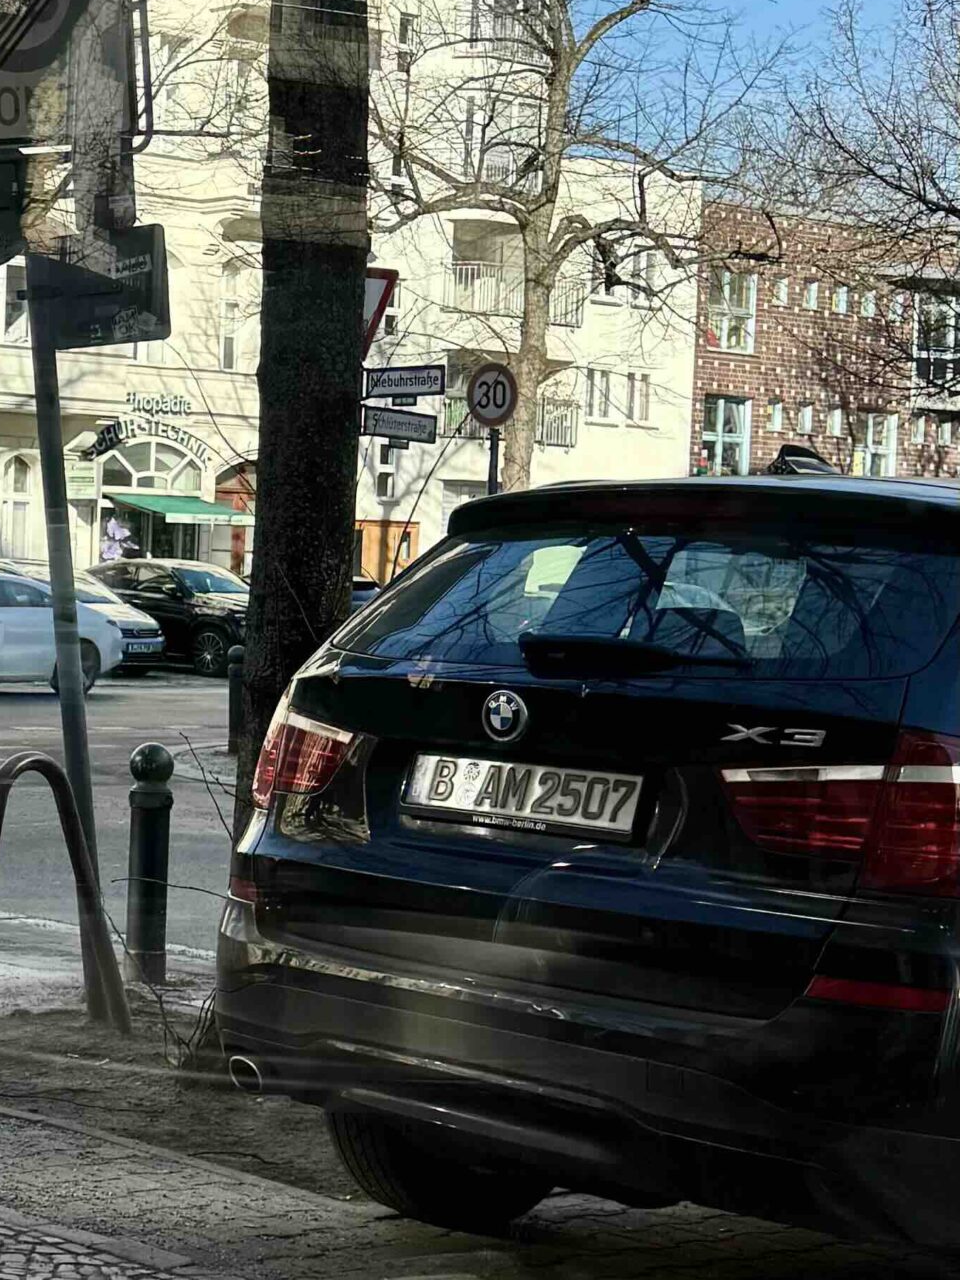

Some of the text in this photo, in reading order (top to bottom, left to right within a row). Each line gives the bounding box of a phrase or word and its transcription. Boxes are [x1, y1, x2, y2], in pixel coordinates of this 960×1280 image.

[370, 370, 439, 389] Niebuhrstraße
[478, 380, 506, 410] 30
[488, 694, 519, 712] BMW
[720, 723, 826, 747] X3
[428, 759, 638, 823] B AM 2507
[472, 815, 547, 831] www.bmw-berlin.de
